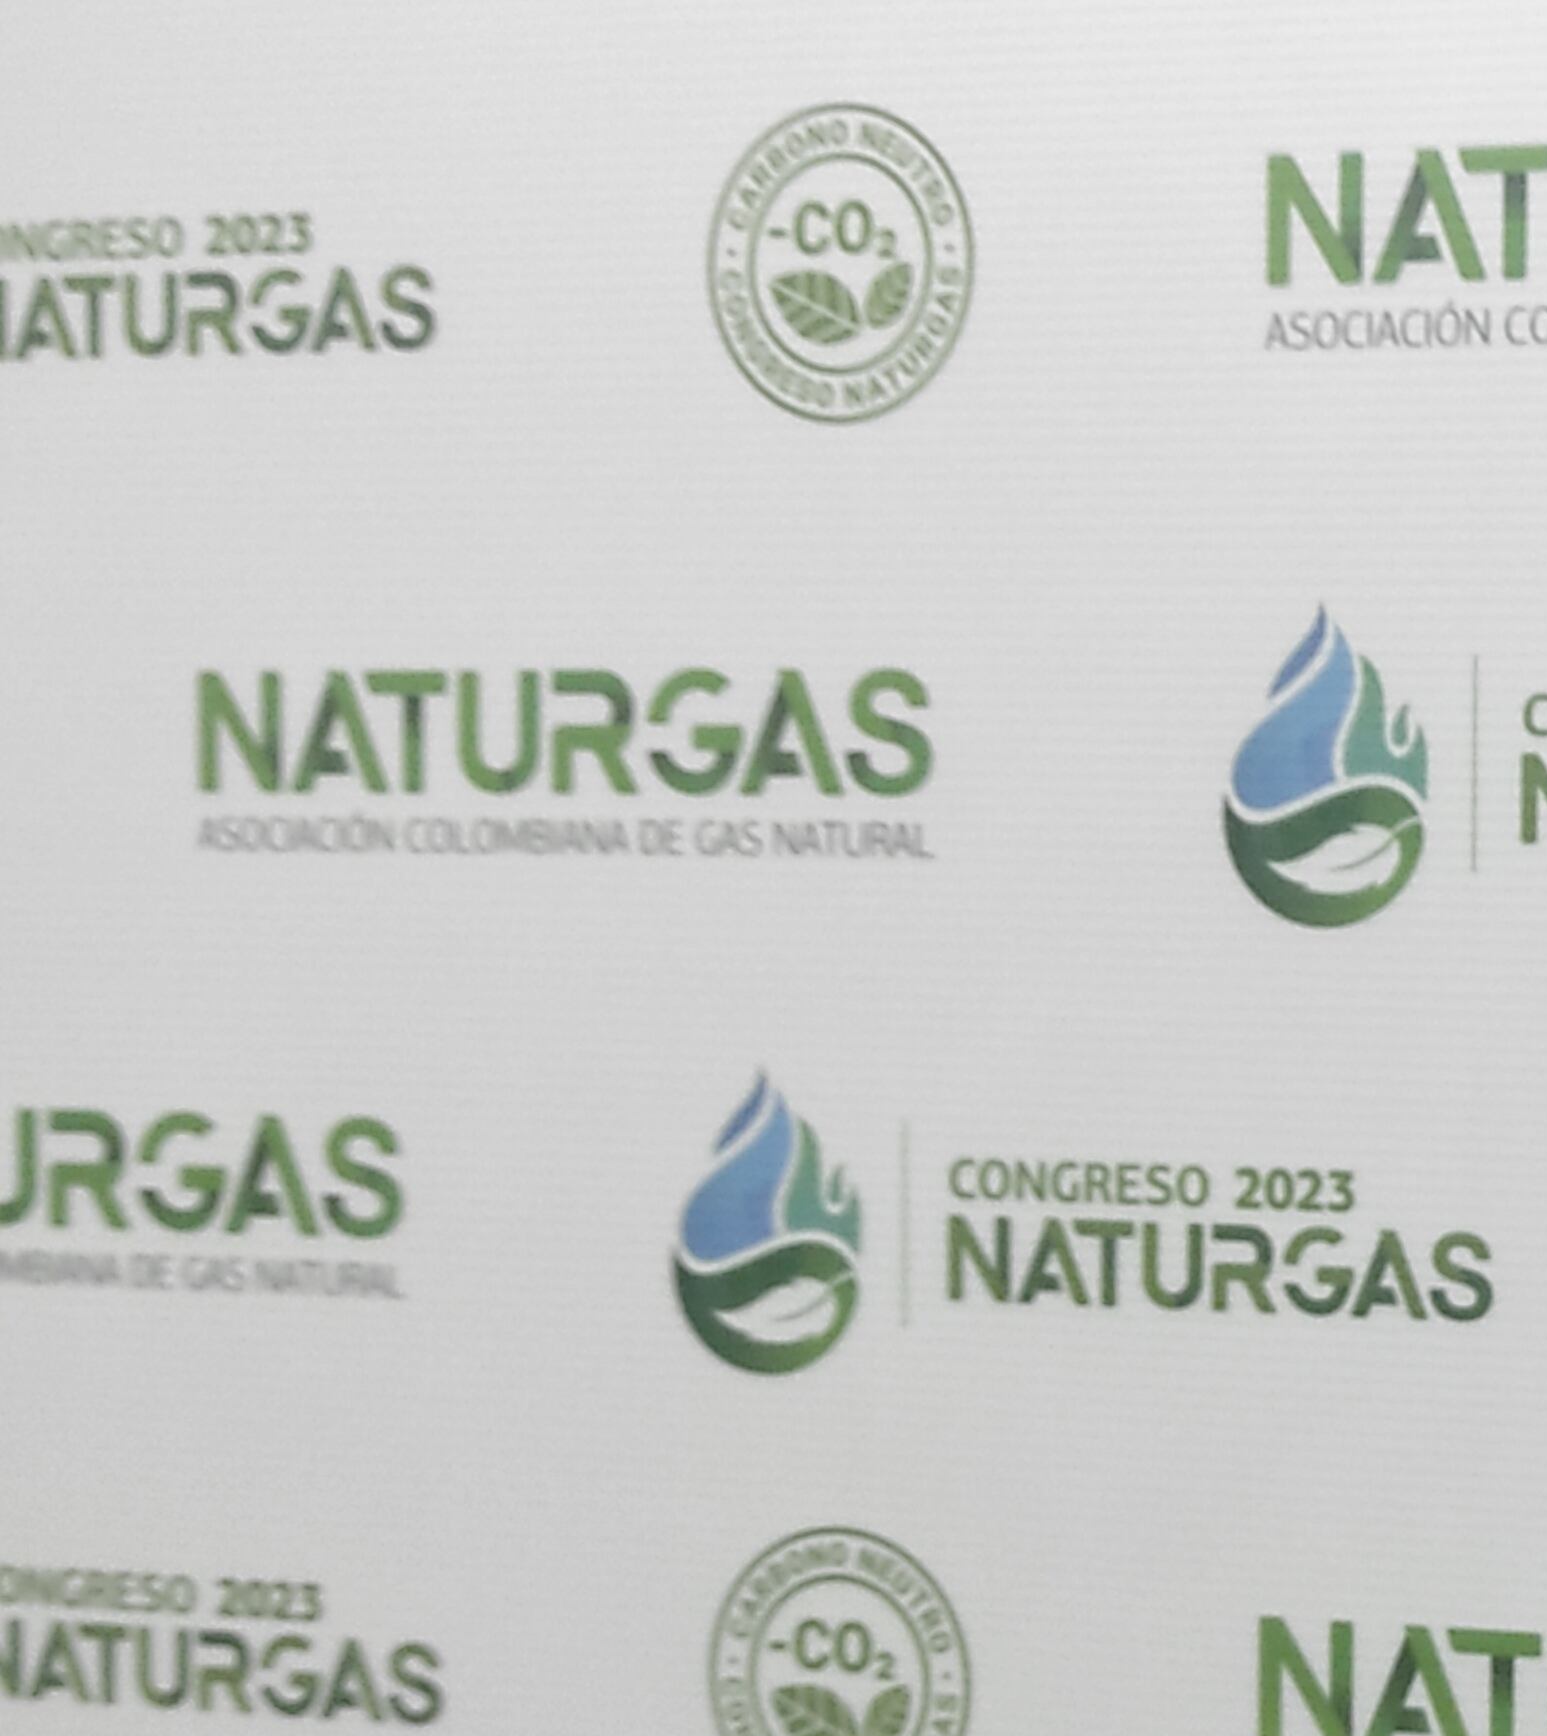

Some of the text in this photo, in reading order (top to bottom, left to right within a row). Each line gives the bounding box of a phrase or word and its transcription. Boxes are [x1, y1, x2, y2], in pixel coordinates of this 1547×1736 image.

[205, 212, 314, 256] 2023
[0, 264, 436, 360] ATURGAS
[1264, 300, 1491, 351] ASOCIACIÓN
[196, 667, 934, 798] NATURGAS
[948, 1157, 1356, 1212] CONGRESO 2023
[946, 1213, 1495, 1323] NATURGAS
